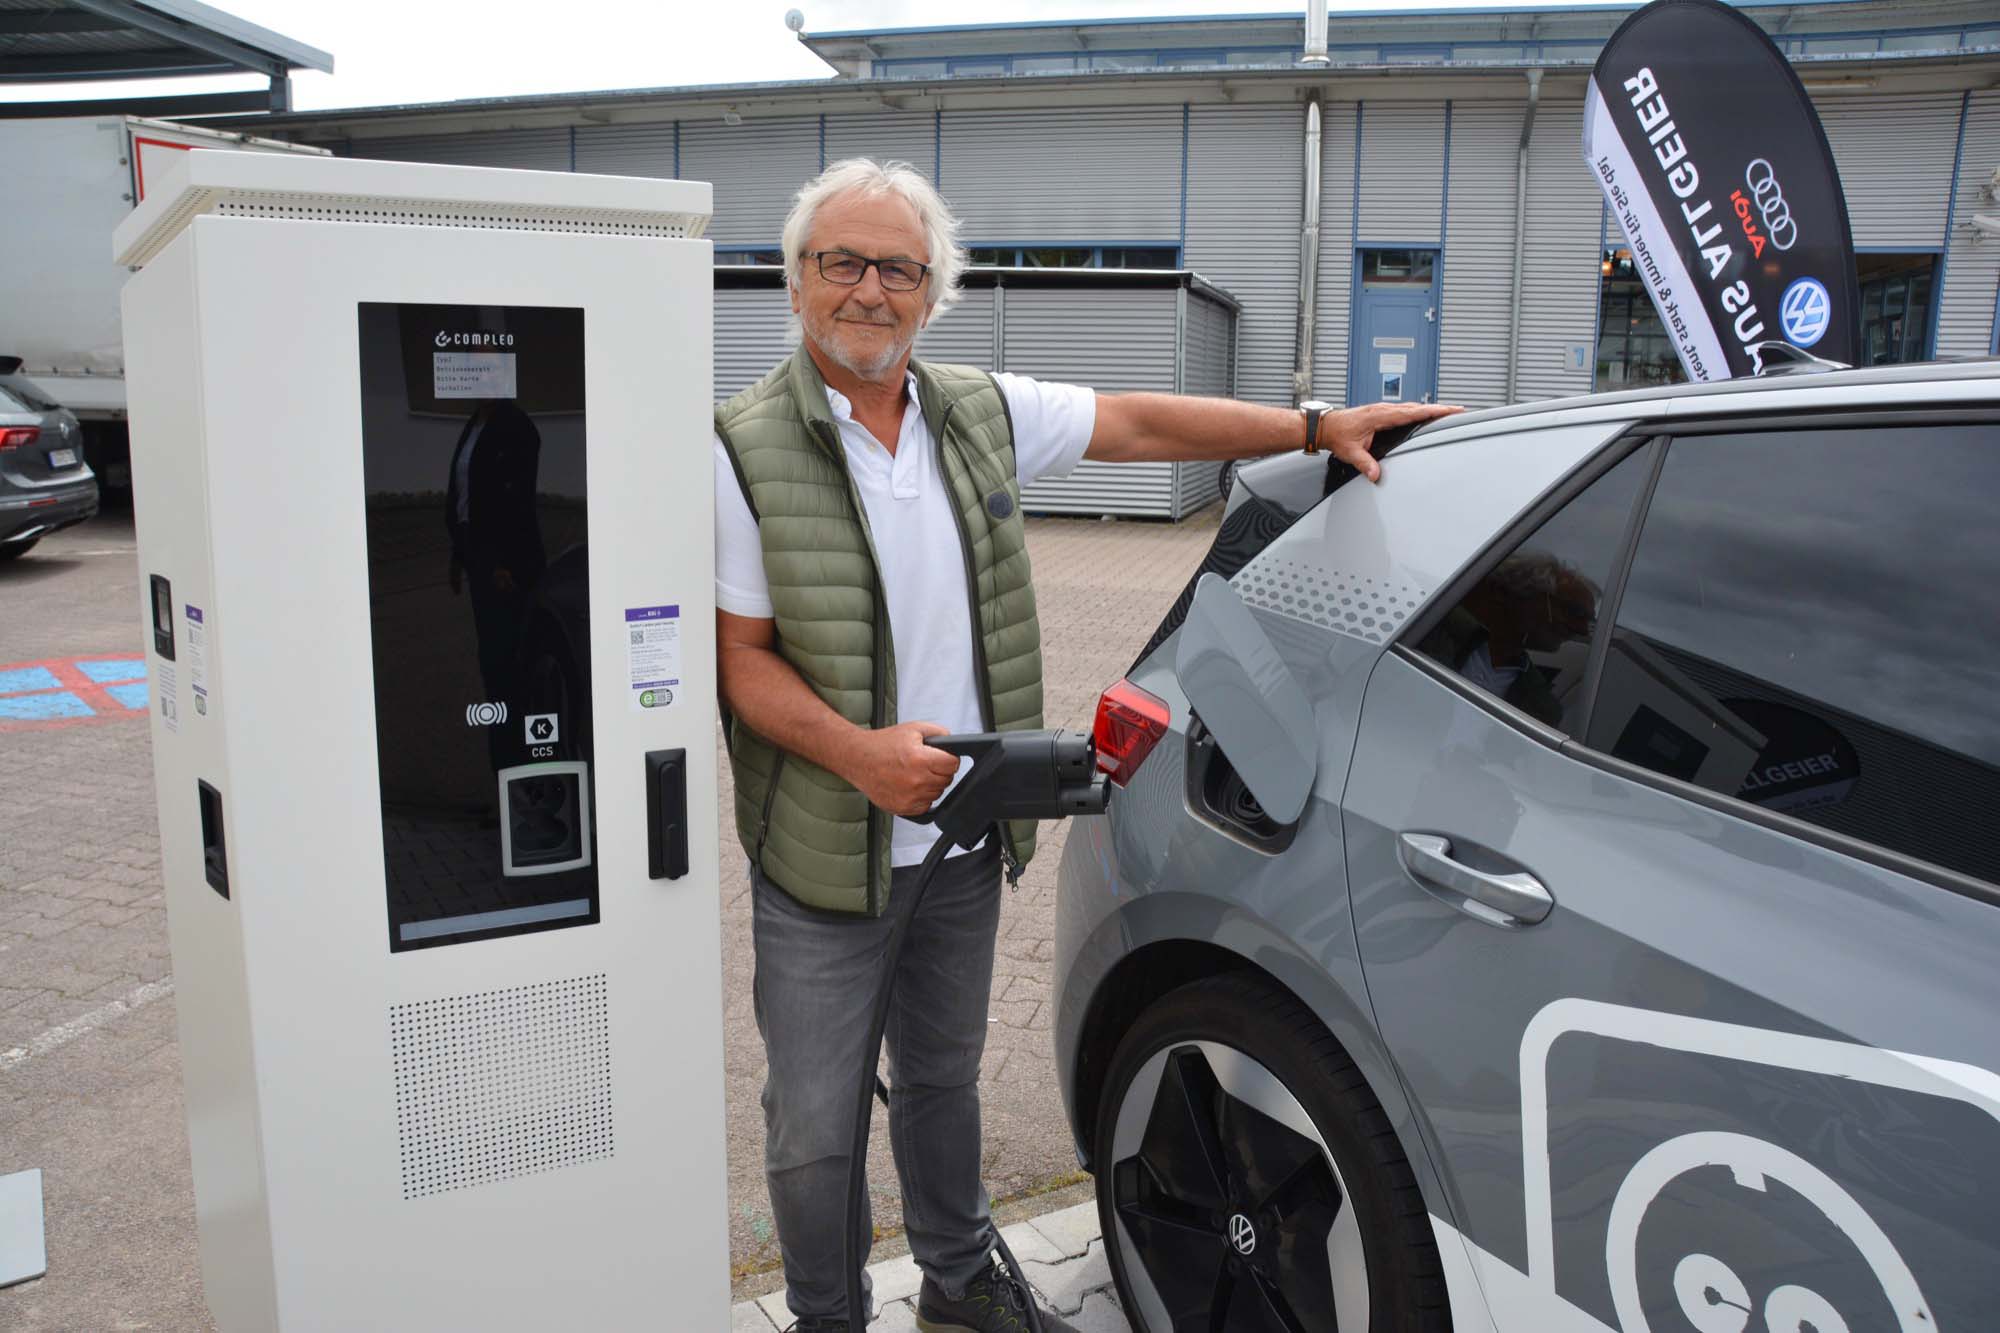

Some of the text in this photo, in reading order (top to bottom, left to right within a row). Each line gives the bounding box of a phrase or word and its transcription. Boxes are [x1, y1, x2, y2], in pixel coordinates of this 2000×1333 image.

[454, 333, 514, 346] COMPLEO
[537, 723, 547, 735] K
[531, 746, 554, 758] CCS
[1739, 754, 1840, 791] LLGEIER
